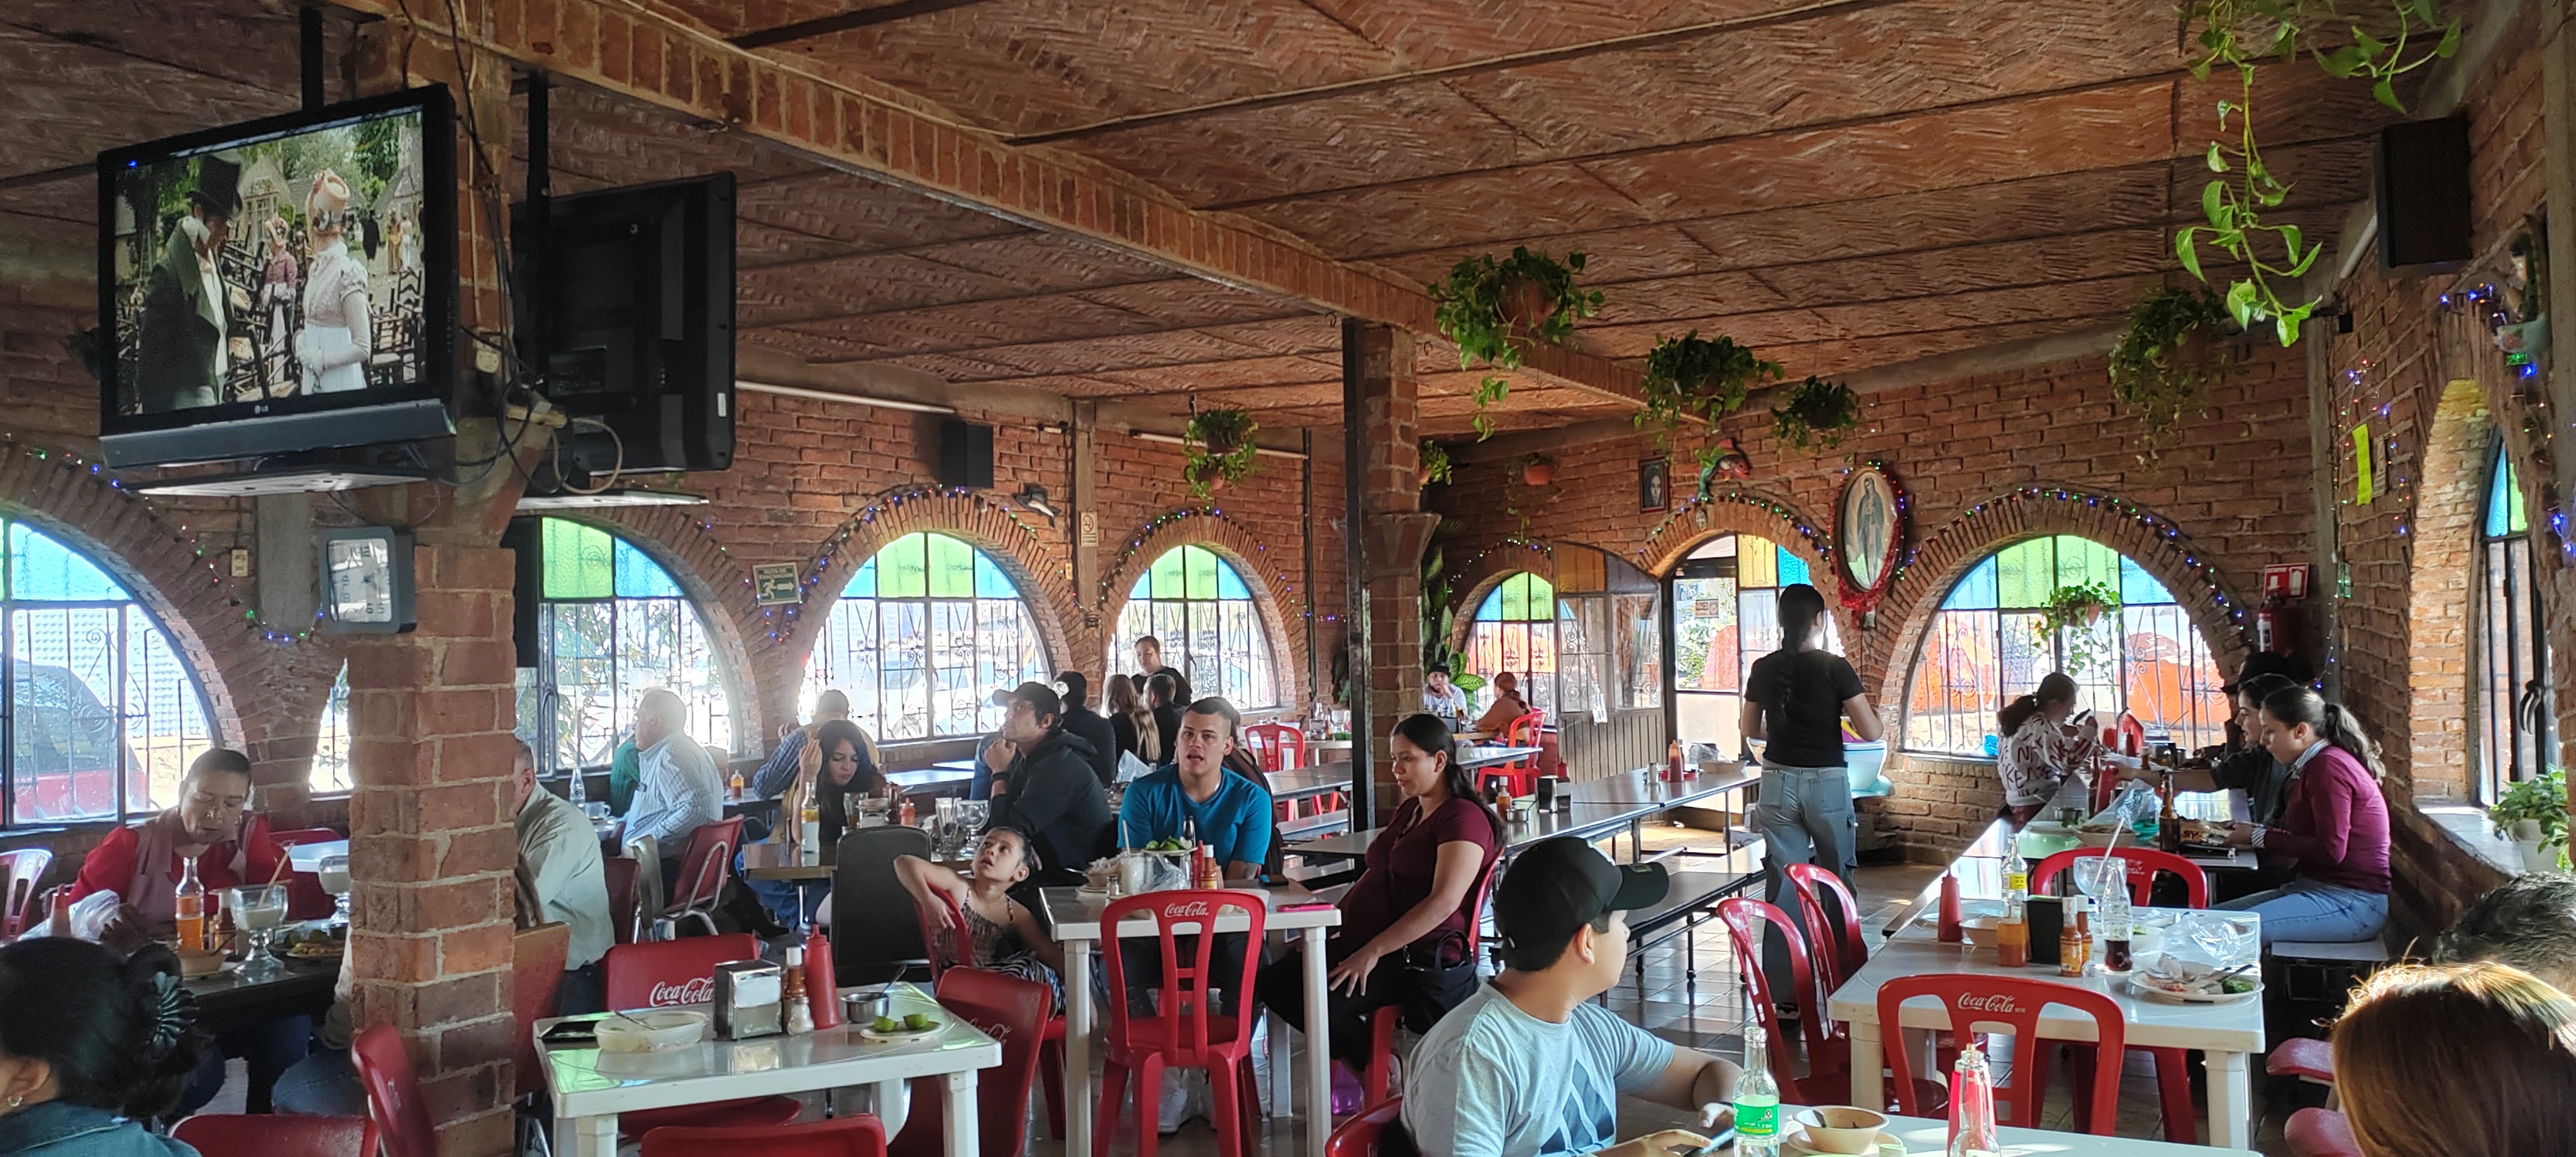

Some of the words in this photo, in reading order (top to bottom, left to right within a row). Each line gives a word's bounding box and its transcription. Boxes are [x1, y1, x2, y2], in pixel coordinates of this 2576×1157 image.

[1164, 901, 1208, 917] Coca-Cola
[650, 977, 714, 1007] Coca-Cola
[1957, 992, 2015, 1013] Coca-Cola
